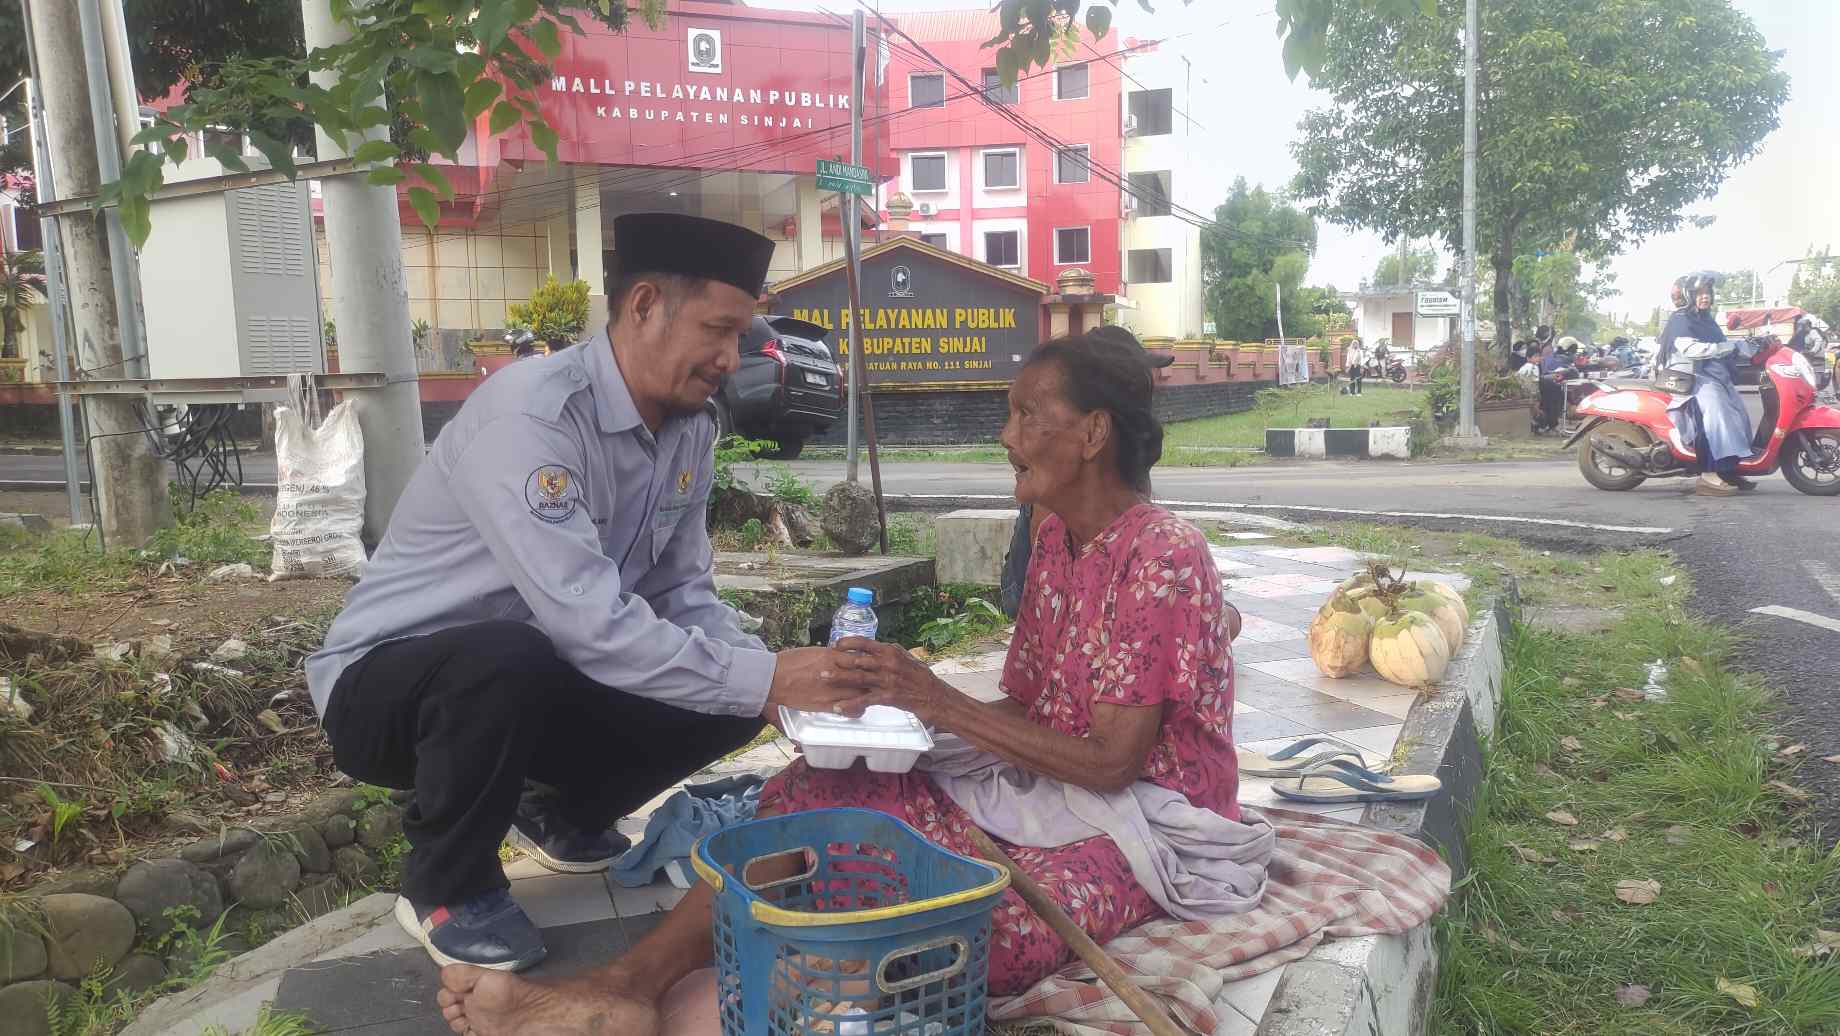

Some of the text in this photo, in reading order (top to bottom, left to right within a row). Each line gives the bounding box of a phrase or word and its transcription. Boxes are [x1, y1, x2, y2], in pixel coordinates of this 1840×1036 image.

[551, 76, 849, 109] MALL PELAYANAN PUBLIK
[596, 105, 812, 129] KABUPATEN SINJAI
[793, 308, 1016, 329] MAL PLAYANAN PUBLIK
[839, 337, 932, 354] KBUPATEN
[901, 362, 924, 370] RAYA
[964, 361, 992, 369] SINJAI
